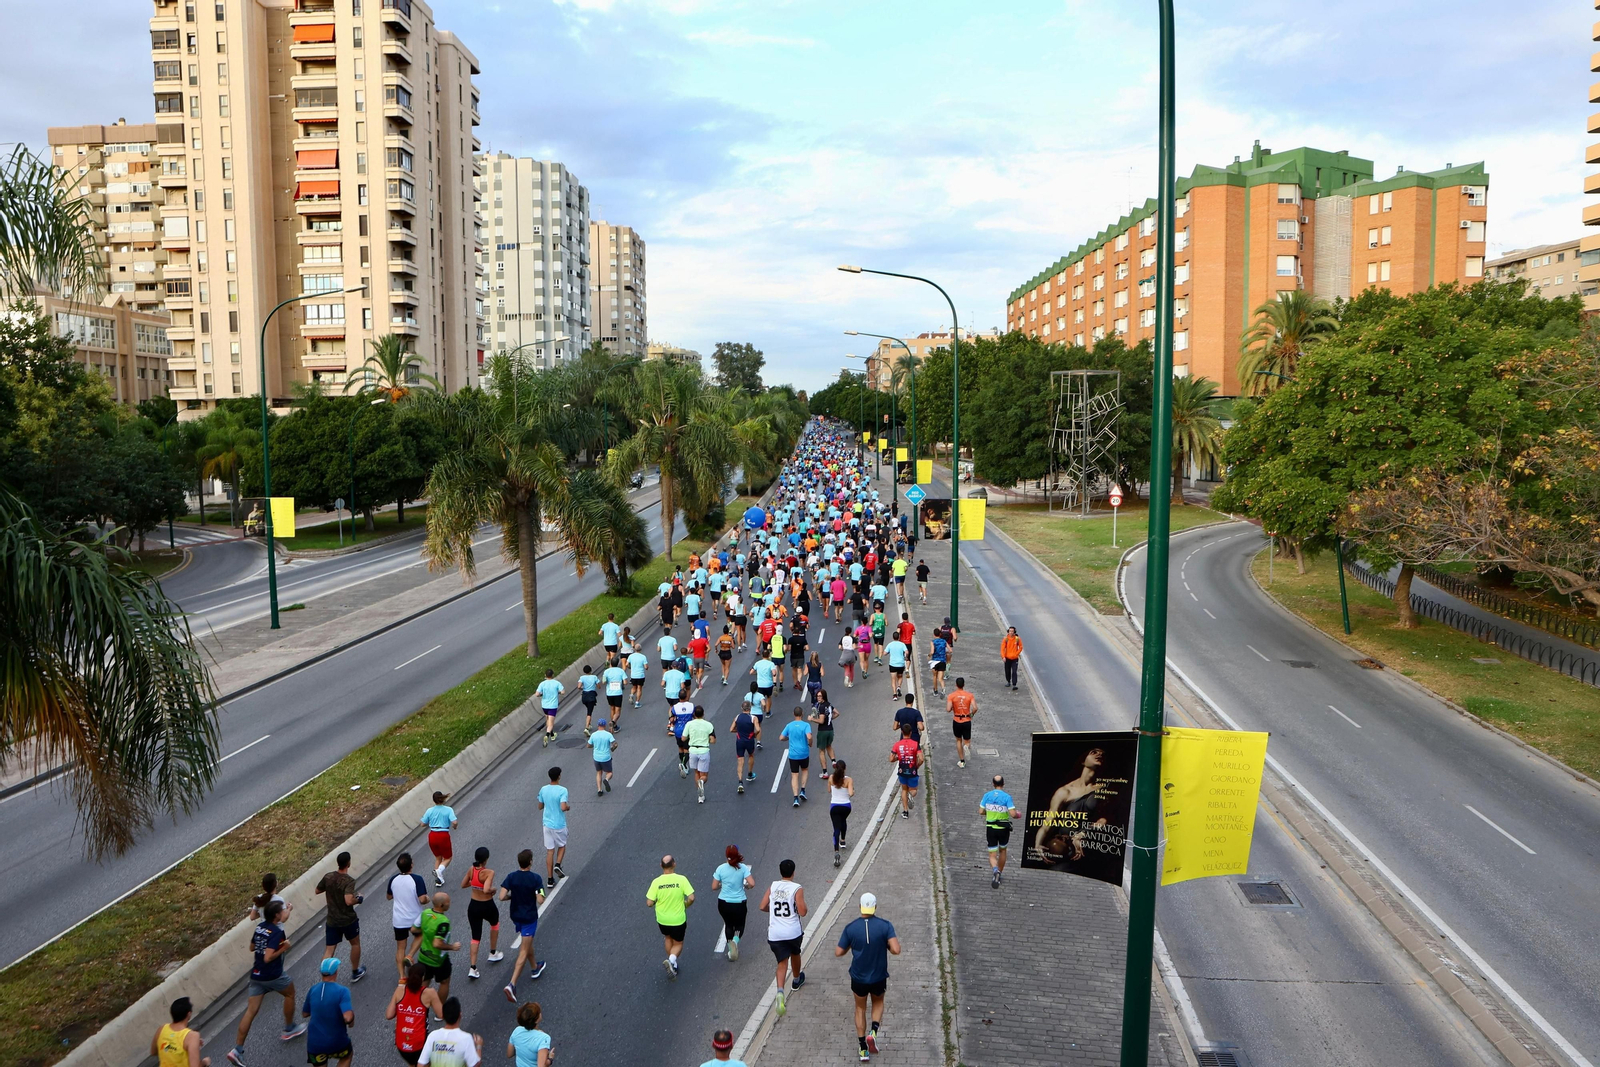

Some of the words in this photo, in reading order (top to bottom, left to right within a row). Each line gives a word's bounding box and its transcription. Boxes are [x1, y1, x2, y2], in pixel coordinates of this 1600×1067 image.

[1215, 748, 1244, 757] PEREDA
[1213, 762, 1250, 771] MURILLO
[1211, 774, 1256, 784] GIORDANO
[1209, 788, 1245, 796] ORRENTE
[1207, 801, 1238, 809] RIBALTA
[1030, 811, 1088, 820] FIERAMENTE
[1206, 812, 1244, 823] MARTÍNEZ
[1030, 820, 1078, 828] HUMANOS
[1081, 821, 1124, 837] RETRATOS
[1203, 836, 1227, 844] CANO
[1080, 840, 1121, 857] BARROCA
[1203, 850, 1224, 858] MENA
[1202, 861, 1242, 871] VELÁZQUEZ
[774, 901, 791, 917] 23
[398, 1003, 425, 1014] C.A.C.
